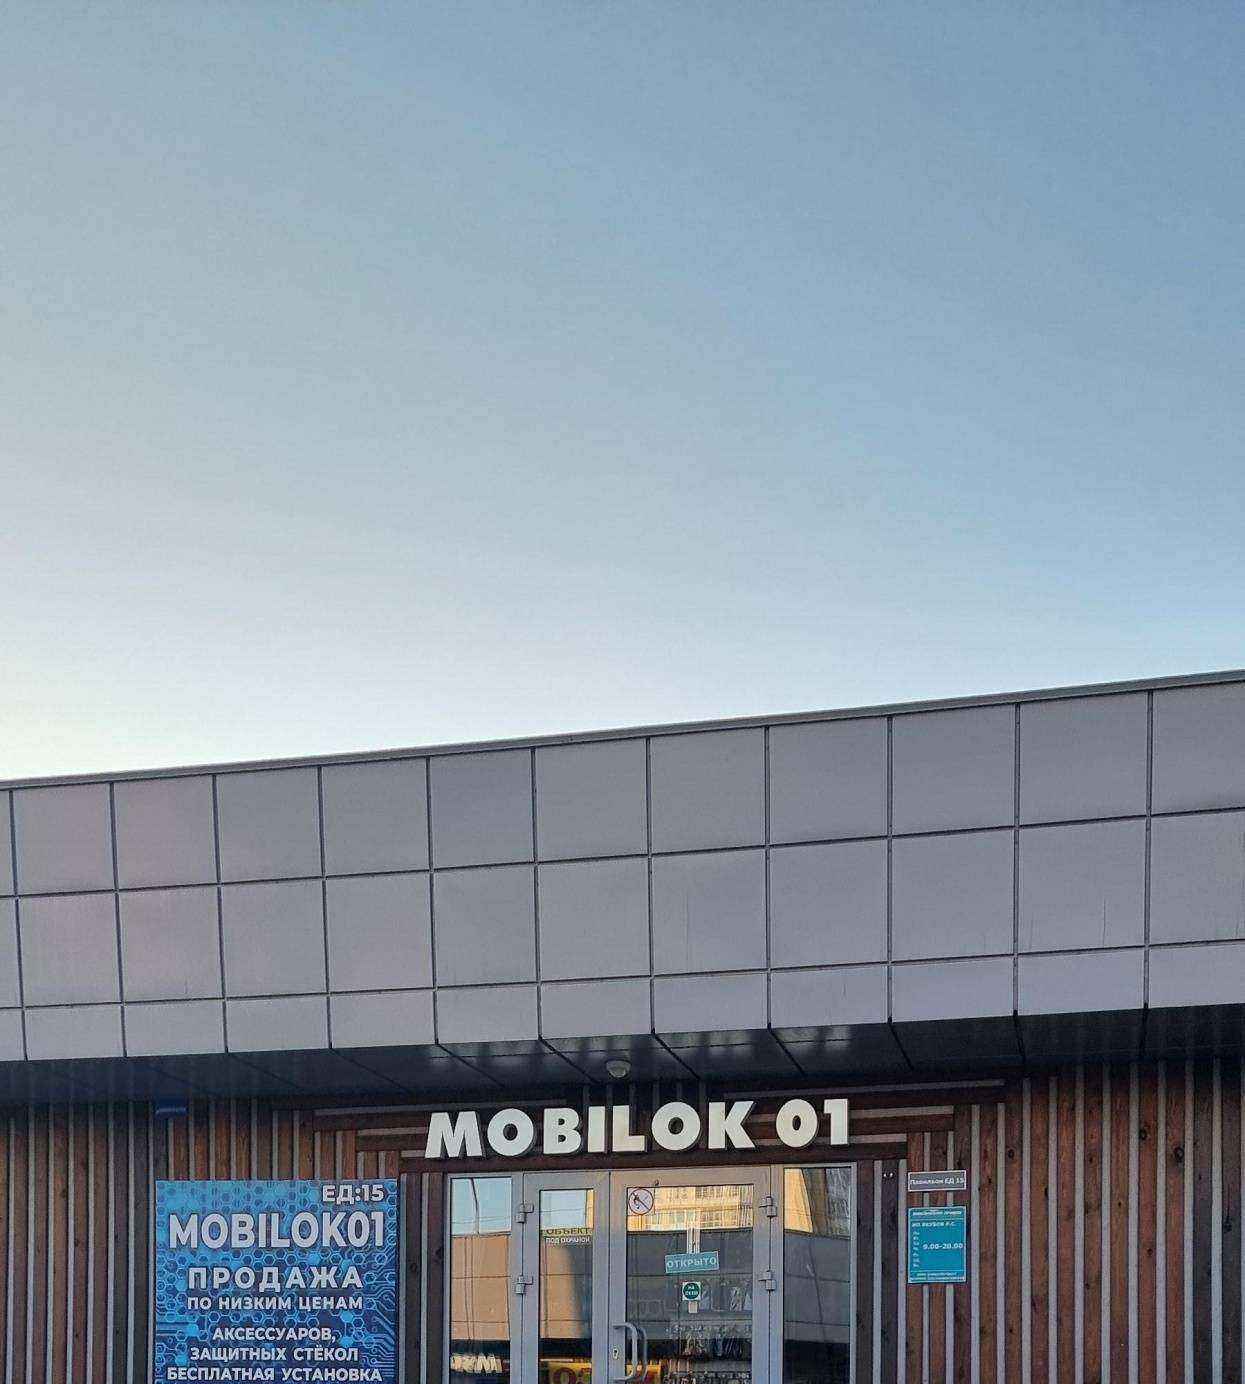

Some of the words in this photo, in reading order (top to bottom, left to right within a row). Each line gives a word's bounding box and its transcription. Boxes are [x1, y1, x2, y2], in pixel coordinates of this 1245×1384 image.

[425, 1100, 757, 1159] MOBILOK
[776, 1098, 850, 1148] 01
[322, 1185, 385, 1203] ЕД:15
[169, 1211, 384, 1249] MOBILOK01
[667, 1256, 717, 1268] ОТКРЫТО
[189, 1267, 363, 1293] ПРОДАЖА
[188, 1297, 211, 1310] ПО
[219, 1297, 291, 1310] НИЗКИМ
[300, 1297, 363, 1311] ЦЕНАМ
[212, 1327, 336, 1343] АКСЕССУАРОВ,
[190, 1347, 287, 1362] ЗАЩИТНЫХ
[294, 1345, 359, 1361] СТЁКОЛ
[167, 1367, 275, 1381] БЕСПЛАТНАЯ
[282, 1367, 383, 1382] УСТАНОВКА
